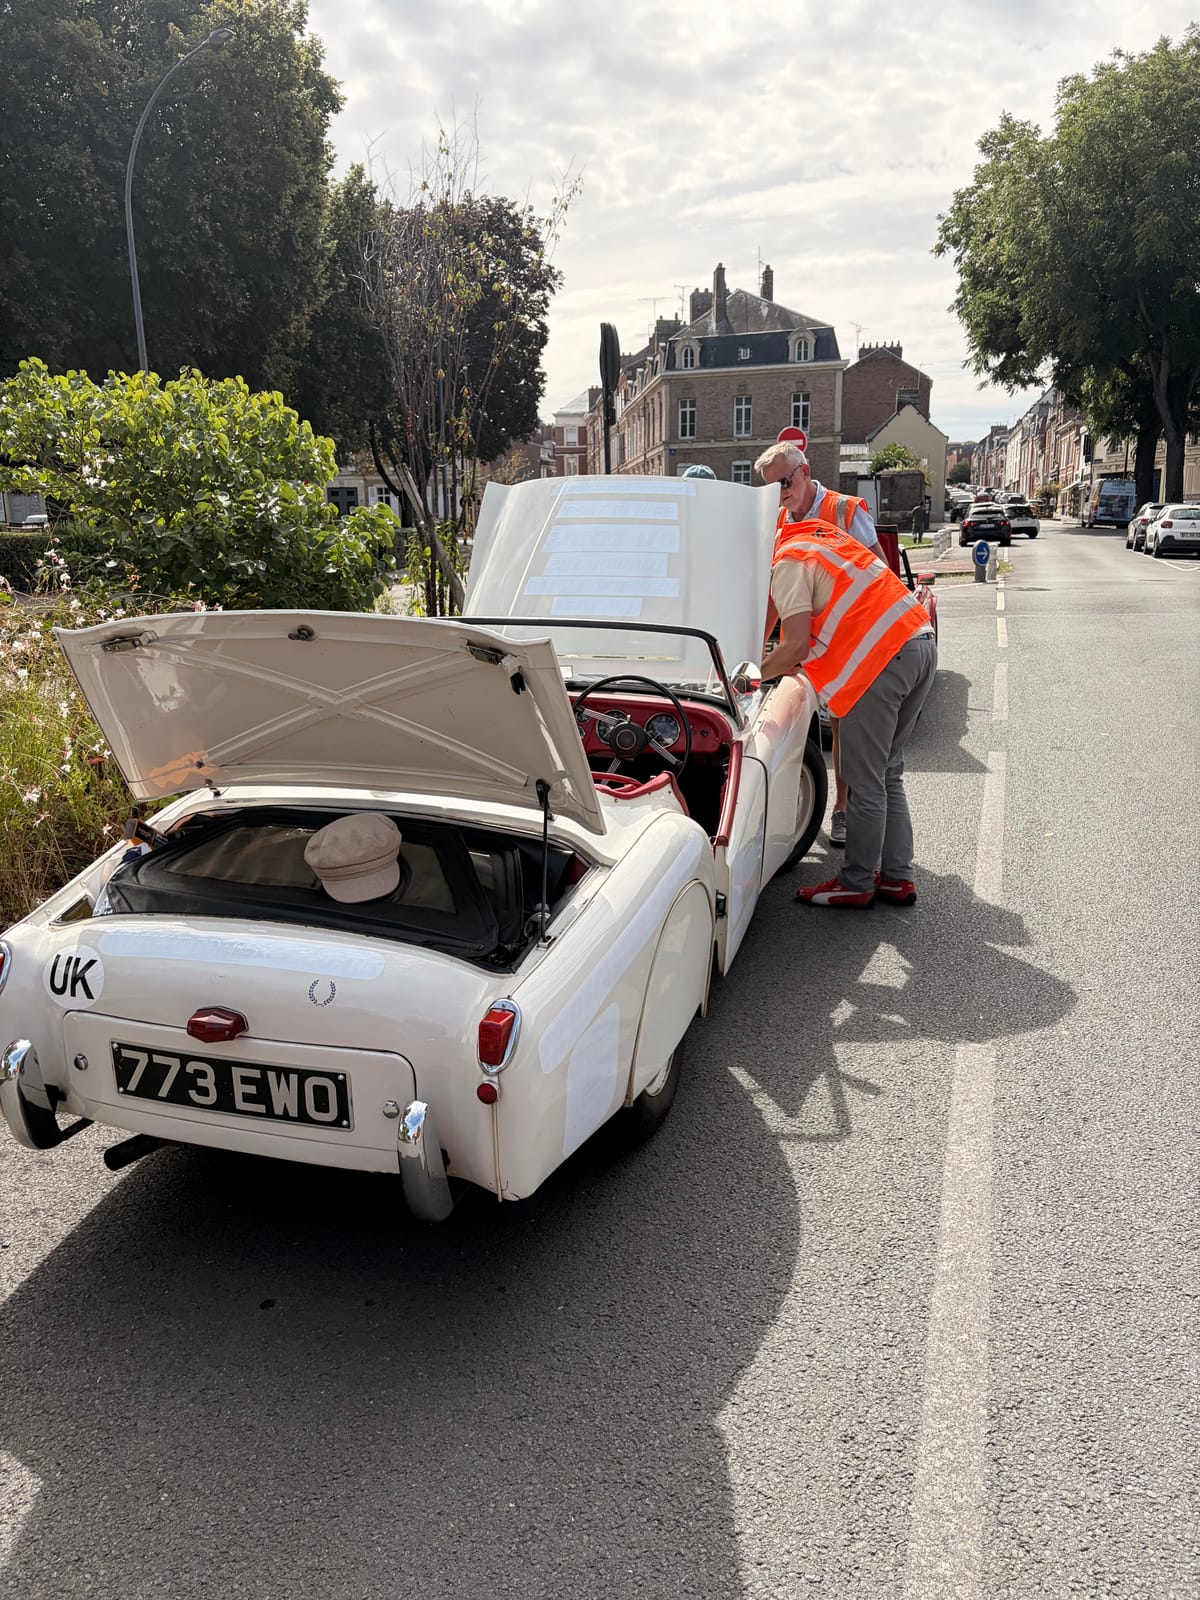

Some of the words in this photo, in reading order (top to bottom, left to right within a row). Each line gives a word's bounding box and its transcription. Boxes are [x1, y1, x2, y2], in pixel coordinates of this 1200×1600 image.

[50, 954, 98, 1000] UK
[120, 1048, 218, 1106] 773
[231, 1066, 338, 1123] EWO
